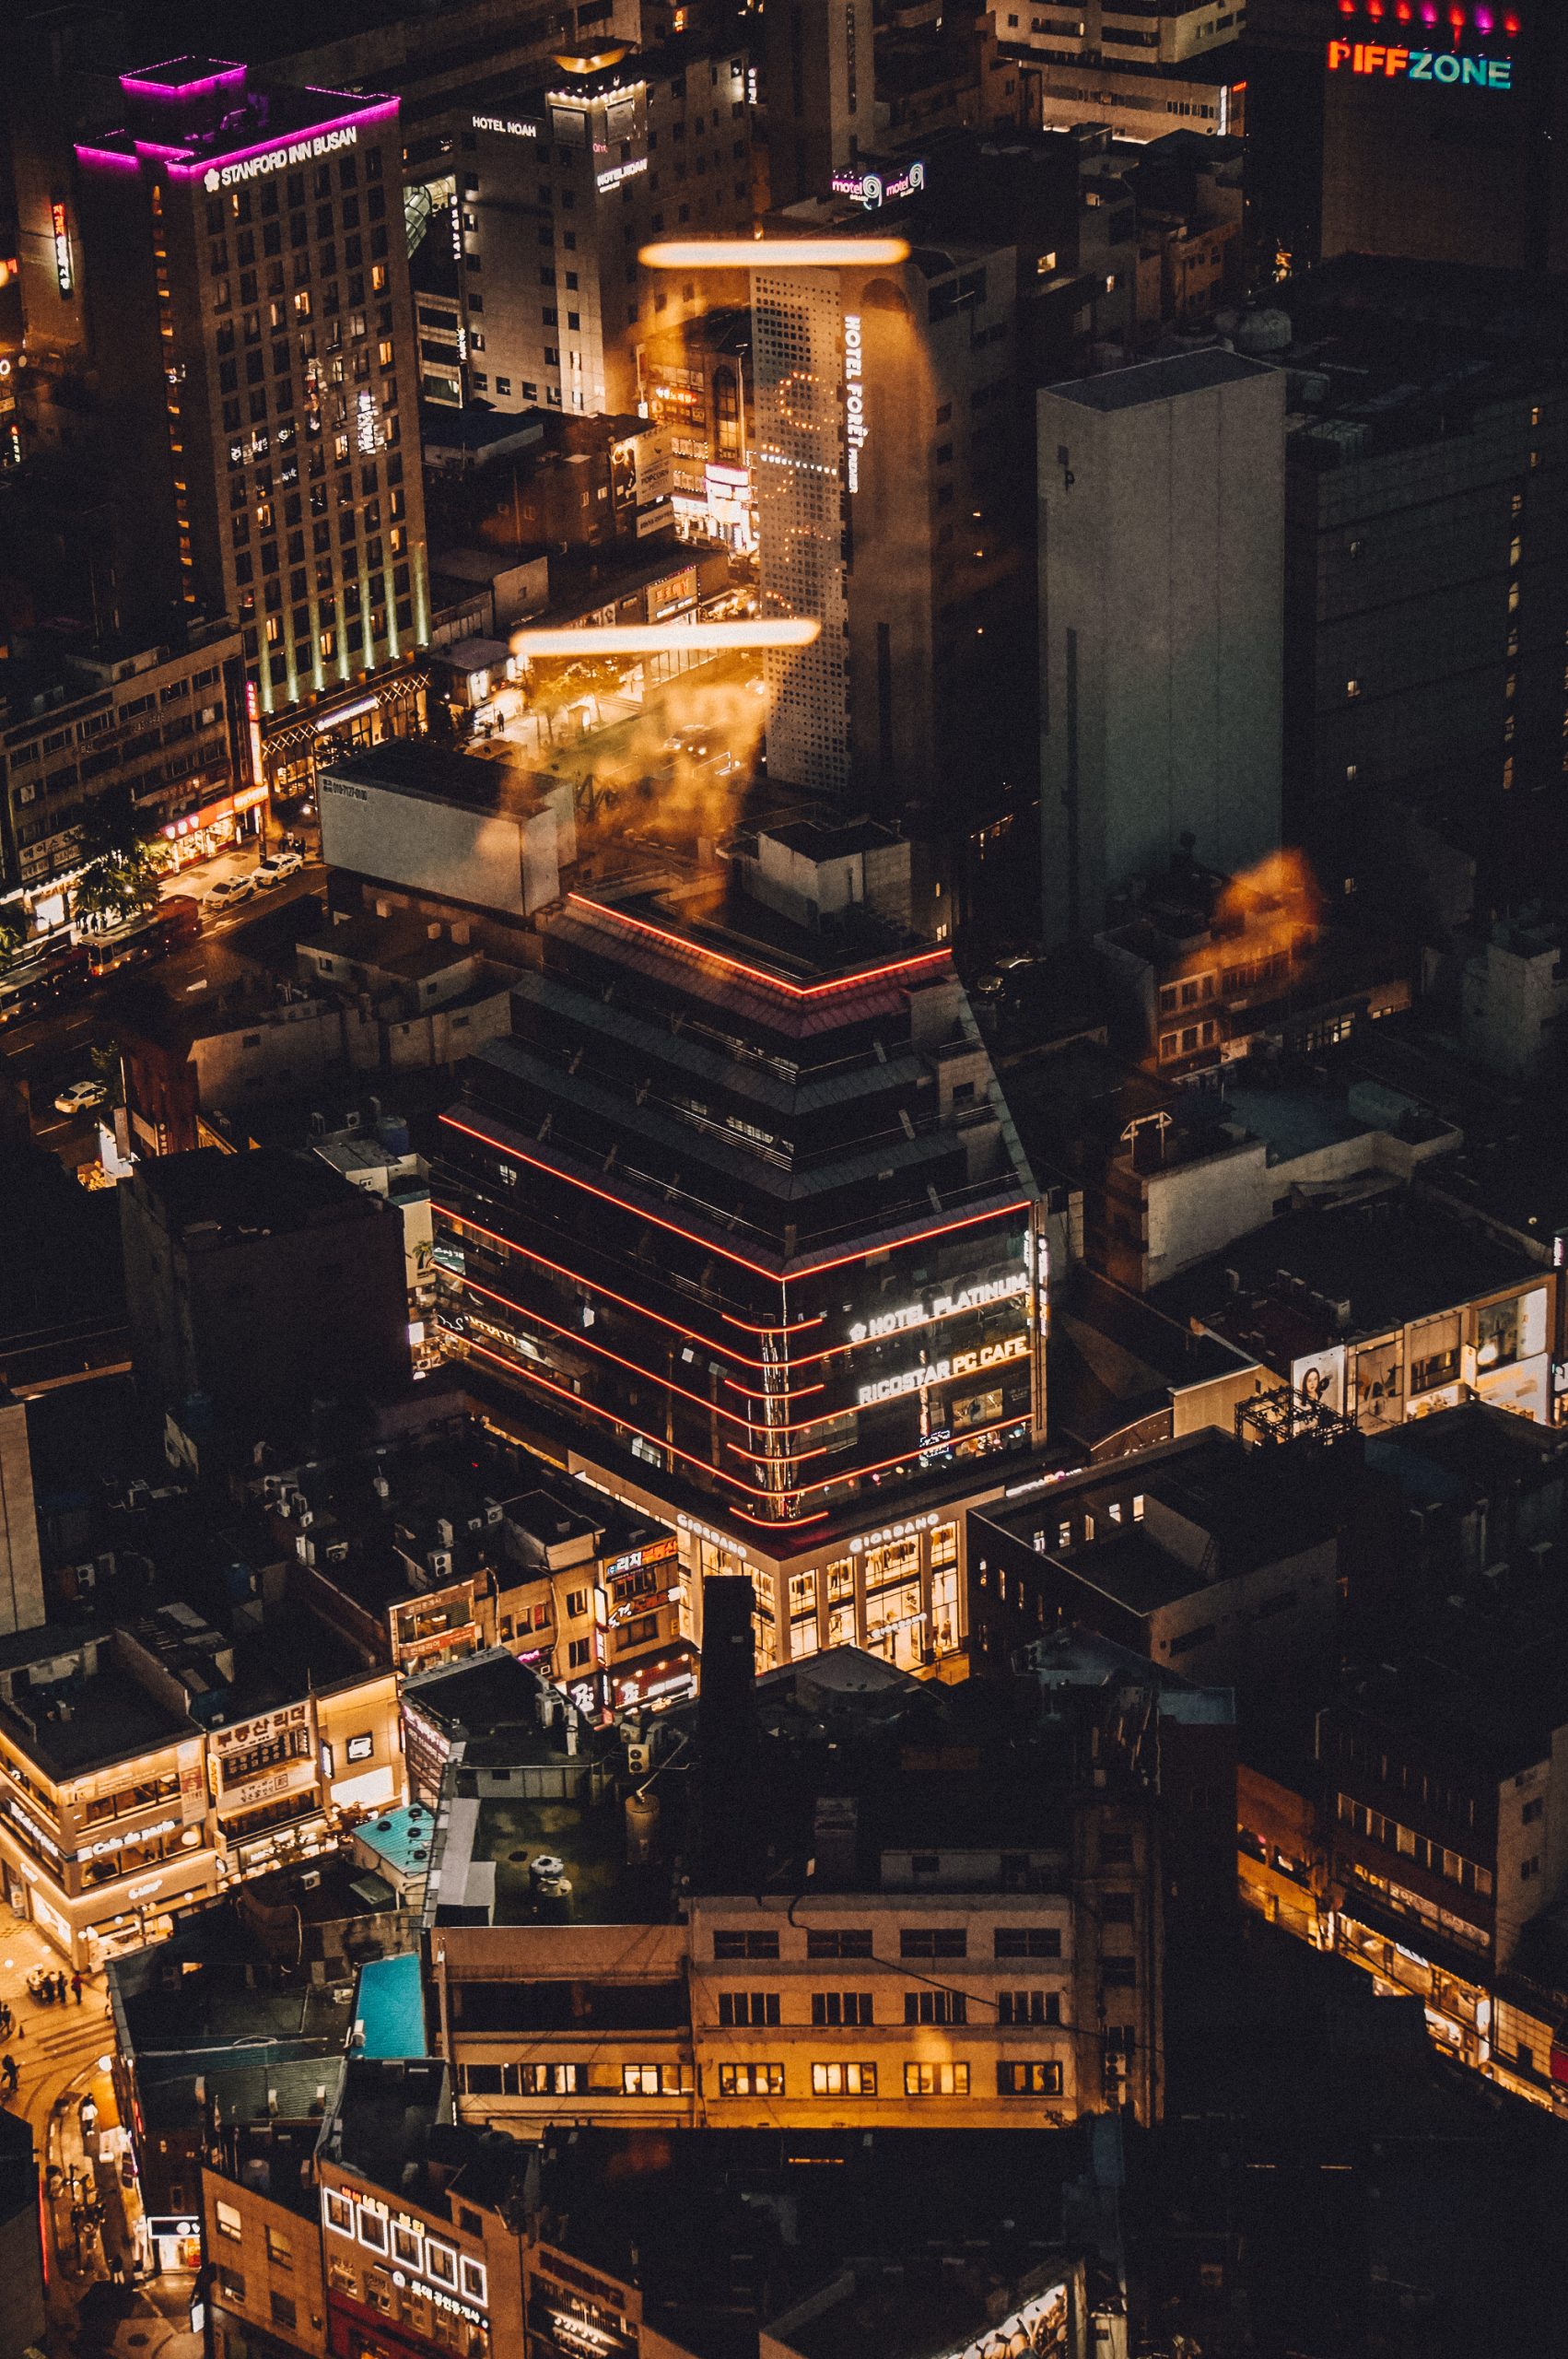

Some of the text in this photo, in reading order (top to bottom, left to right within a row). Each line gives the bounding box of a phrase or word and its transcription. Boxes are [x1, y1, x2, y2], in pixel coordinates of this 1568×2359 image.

[473, 116, 536, 137] HOTEL NOAH
[221, 125, 357, 186] STANFORD INN BUSAN
[832, 181, 863, 195] motel
[885, 176, 908, 197] motel
[845, 316, 861, 380] HOTEL
[869, 1272, 1030, 1338] HOTEL PLATINUM
[859, 1335, 1028, 1406] RICOSTAR PC CAFE
[676, 1513, 748, 1558] GIORDANO
[849, 1512, 940, 1554] GIORDANO
[216, 1705, 306, 1747] 부동산 리더
